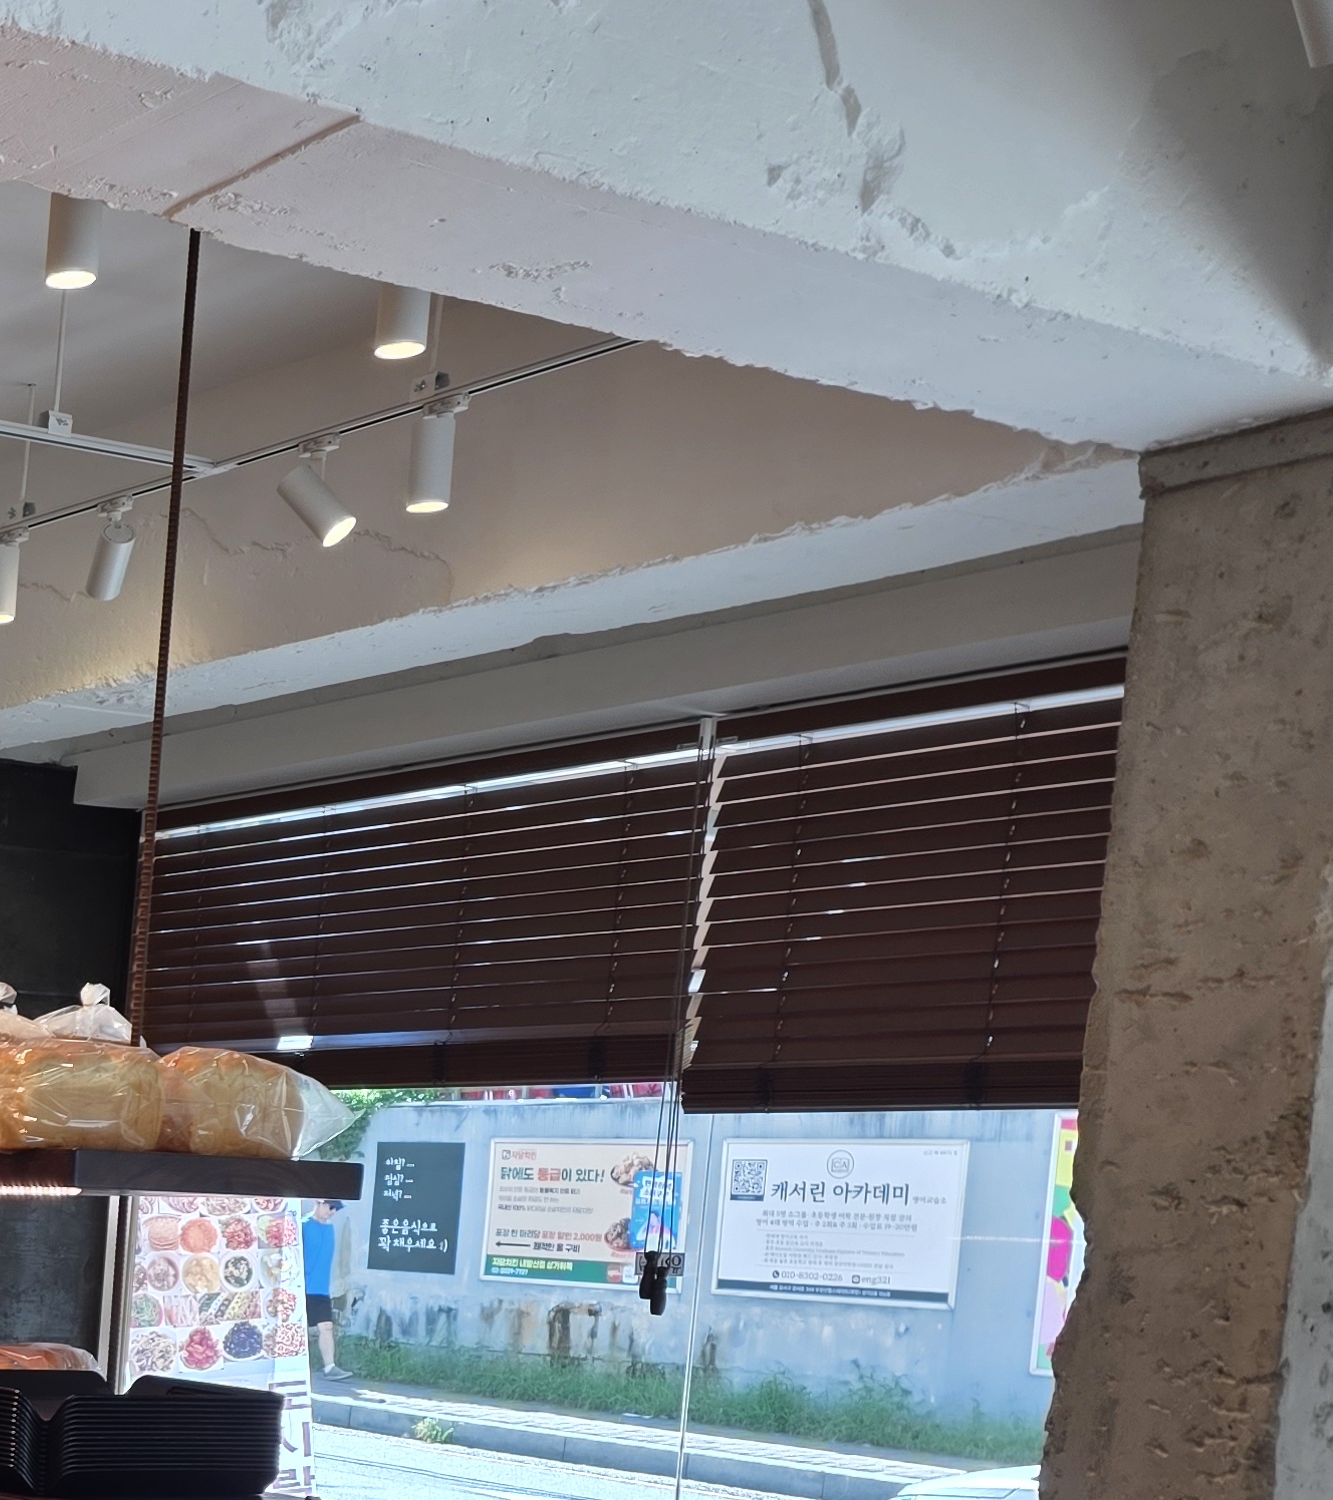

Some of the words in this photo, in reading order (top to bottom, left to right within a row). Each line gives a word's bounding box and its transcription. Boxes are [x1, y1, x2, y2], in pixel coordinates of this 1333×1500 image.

[500, 1166, 534, 1181] 닭에도
[537, 1168, 572, 1182] 등급이
[575, 1168, 605, 1183] 있다!
[770, 1181, 825, 1202] 캐서린
[833, 1181, 909, 1206] 아카데미
